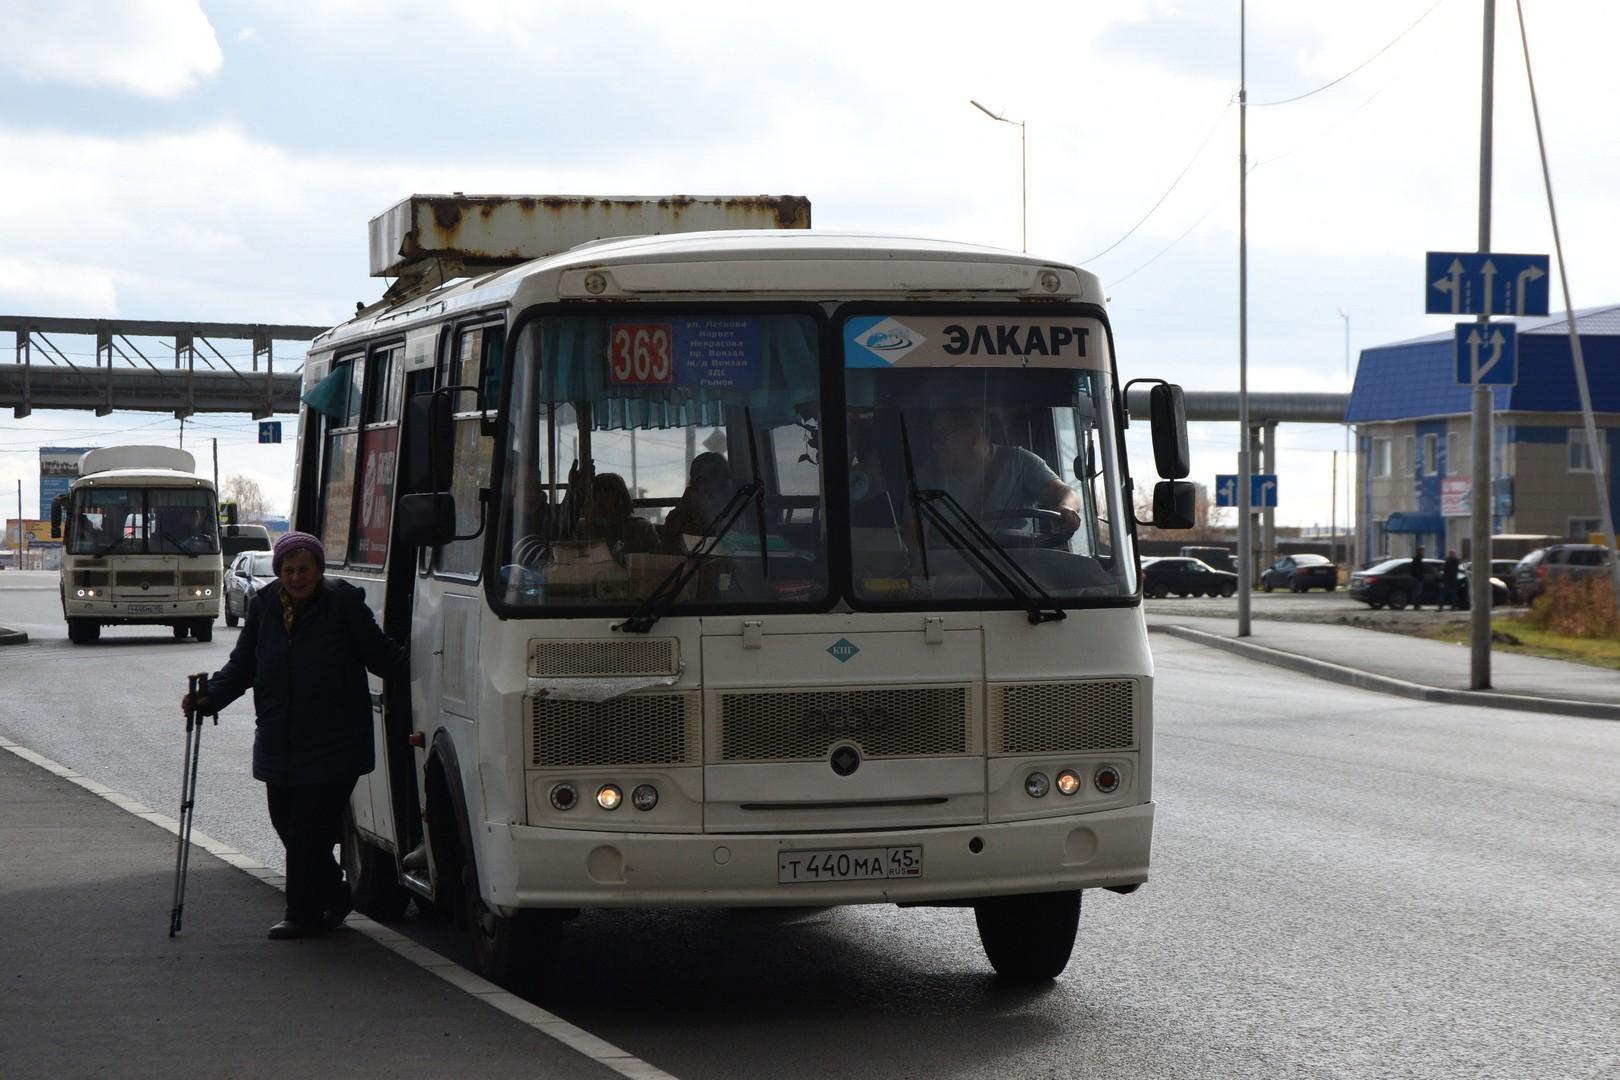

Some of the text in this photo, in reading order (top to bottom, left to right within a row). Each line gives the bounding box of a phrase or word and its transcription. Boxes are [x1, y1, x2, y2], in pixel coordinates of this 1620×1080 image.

[615, 329, 669, 381] 363
[690, 340, 744, 348] Некрасова
[942, 325, 1089, 357] ЭЛКАРТ
[711, 359, 748, 367] Вокзал
[789, 850, 913, 878] Т440МА 45
